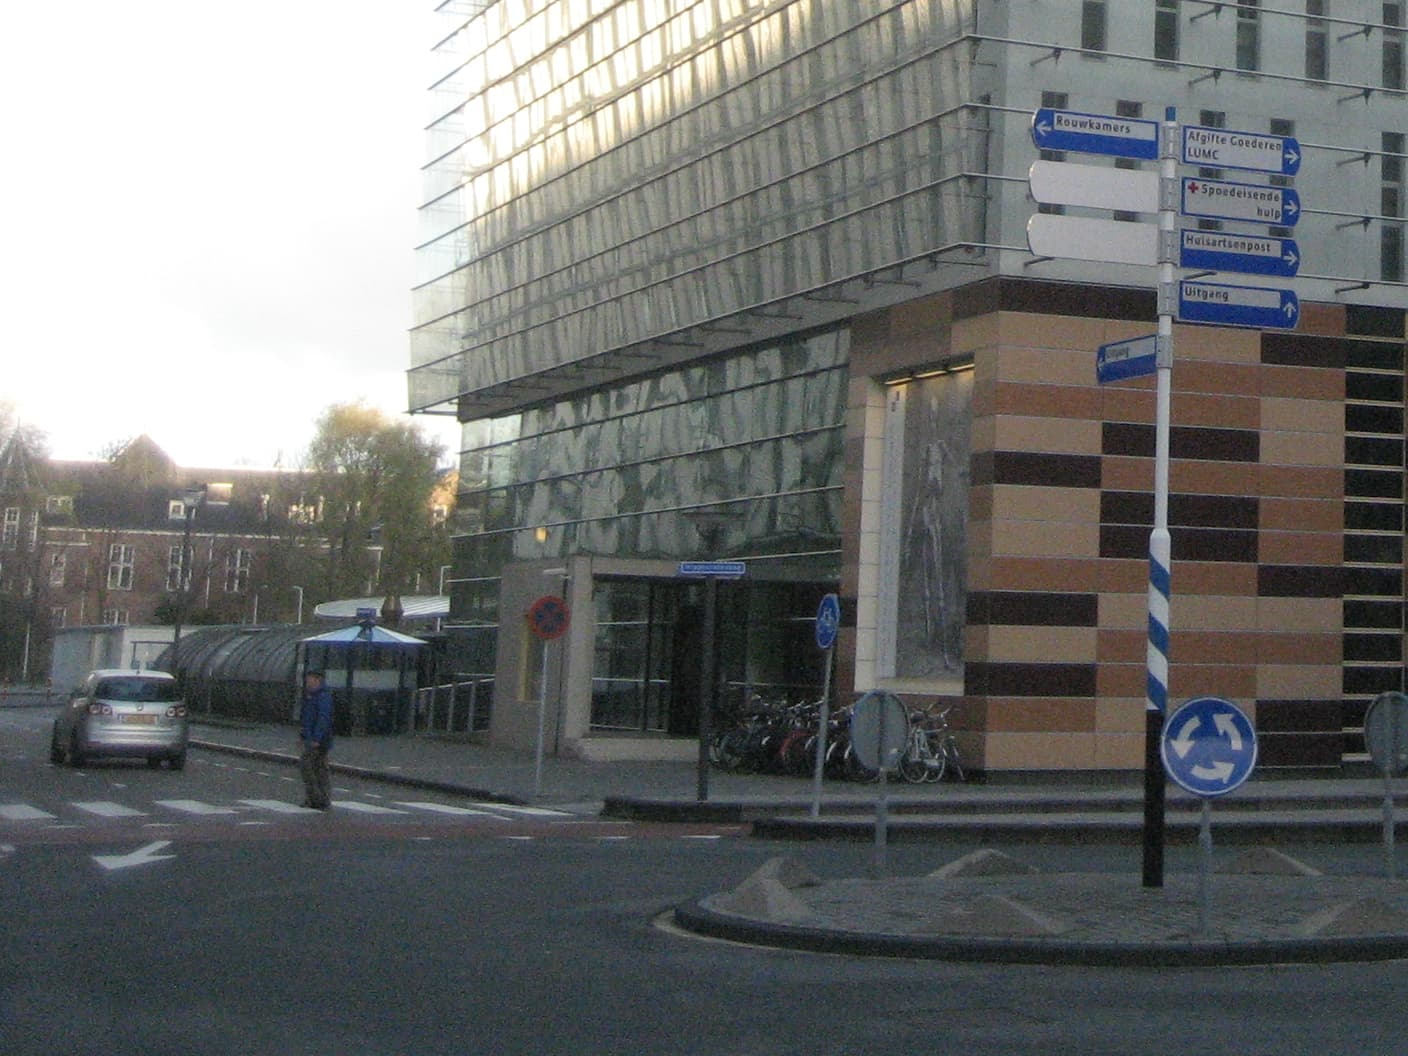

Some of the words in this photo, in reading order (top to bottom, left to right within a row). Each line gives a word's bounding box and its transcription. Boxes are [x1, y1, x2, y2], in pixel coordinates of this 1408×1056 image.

[1056, 115, 1131, 134] Rouwkamers
[1188, 131, 1227, 145] Afgifte
[1230, 136, 1281, 151] Goederen
[1188, 148, 1219, 160] LUMC
[1201, 184, 1280, 202] Spoedeisende
[1257, 207, 1281, 224] hulp
[1186, 235, 1271, 252] Huisartsenpost
[1185, 286, 1229, 302] Uitgang
